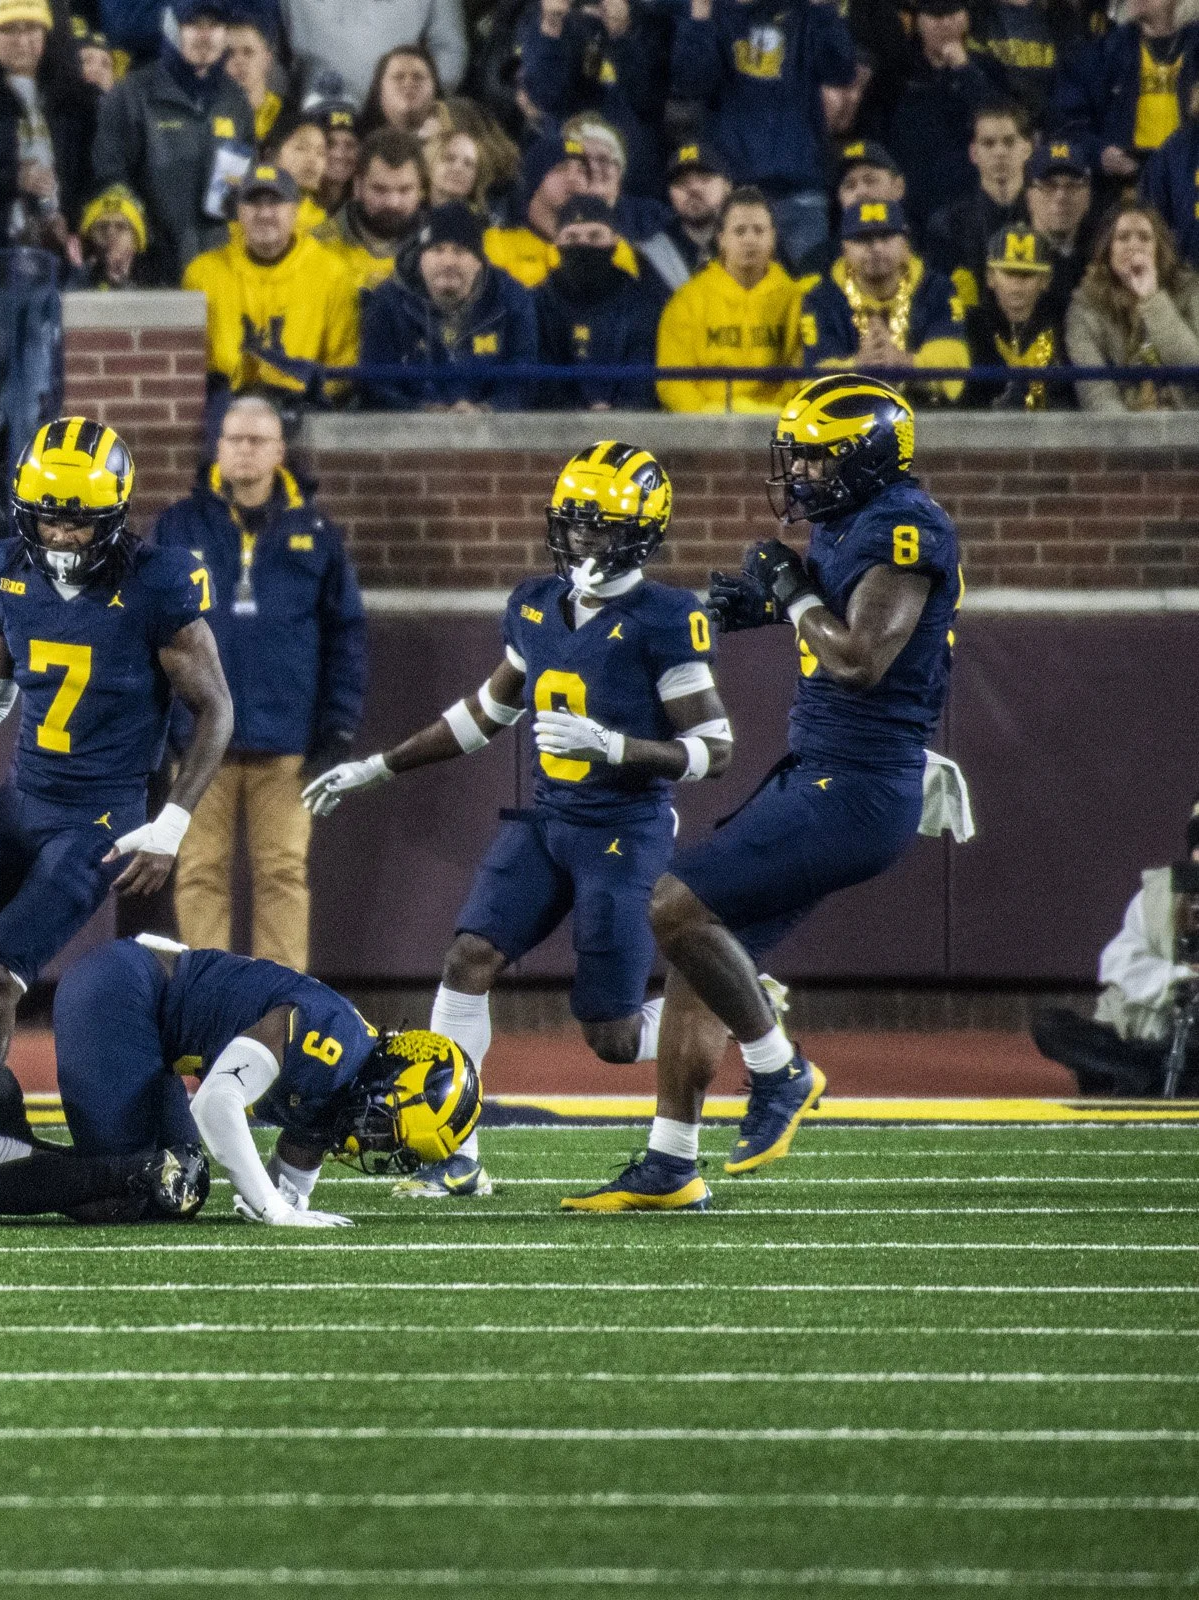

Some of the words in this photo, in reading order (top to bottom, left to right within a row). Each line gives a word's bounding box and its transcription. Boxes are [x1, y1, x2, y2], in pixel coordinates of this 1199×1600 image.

[1004, 232, 1036, 264] M
[893, 524, 920, 565] 8
[190, 567, 211, 612] 7
[689, 611, 711, 652] 0
[29, 639, 92, 753] 7
